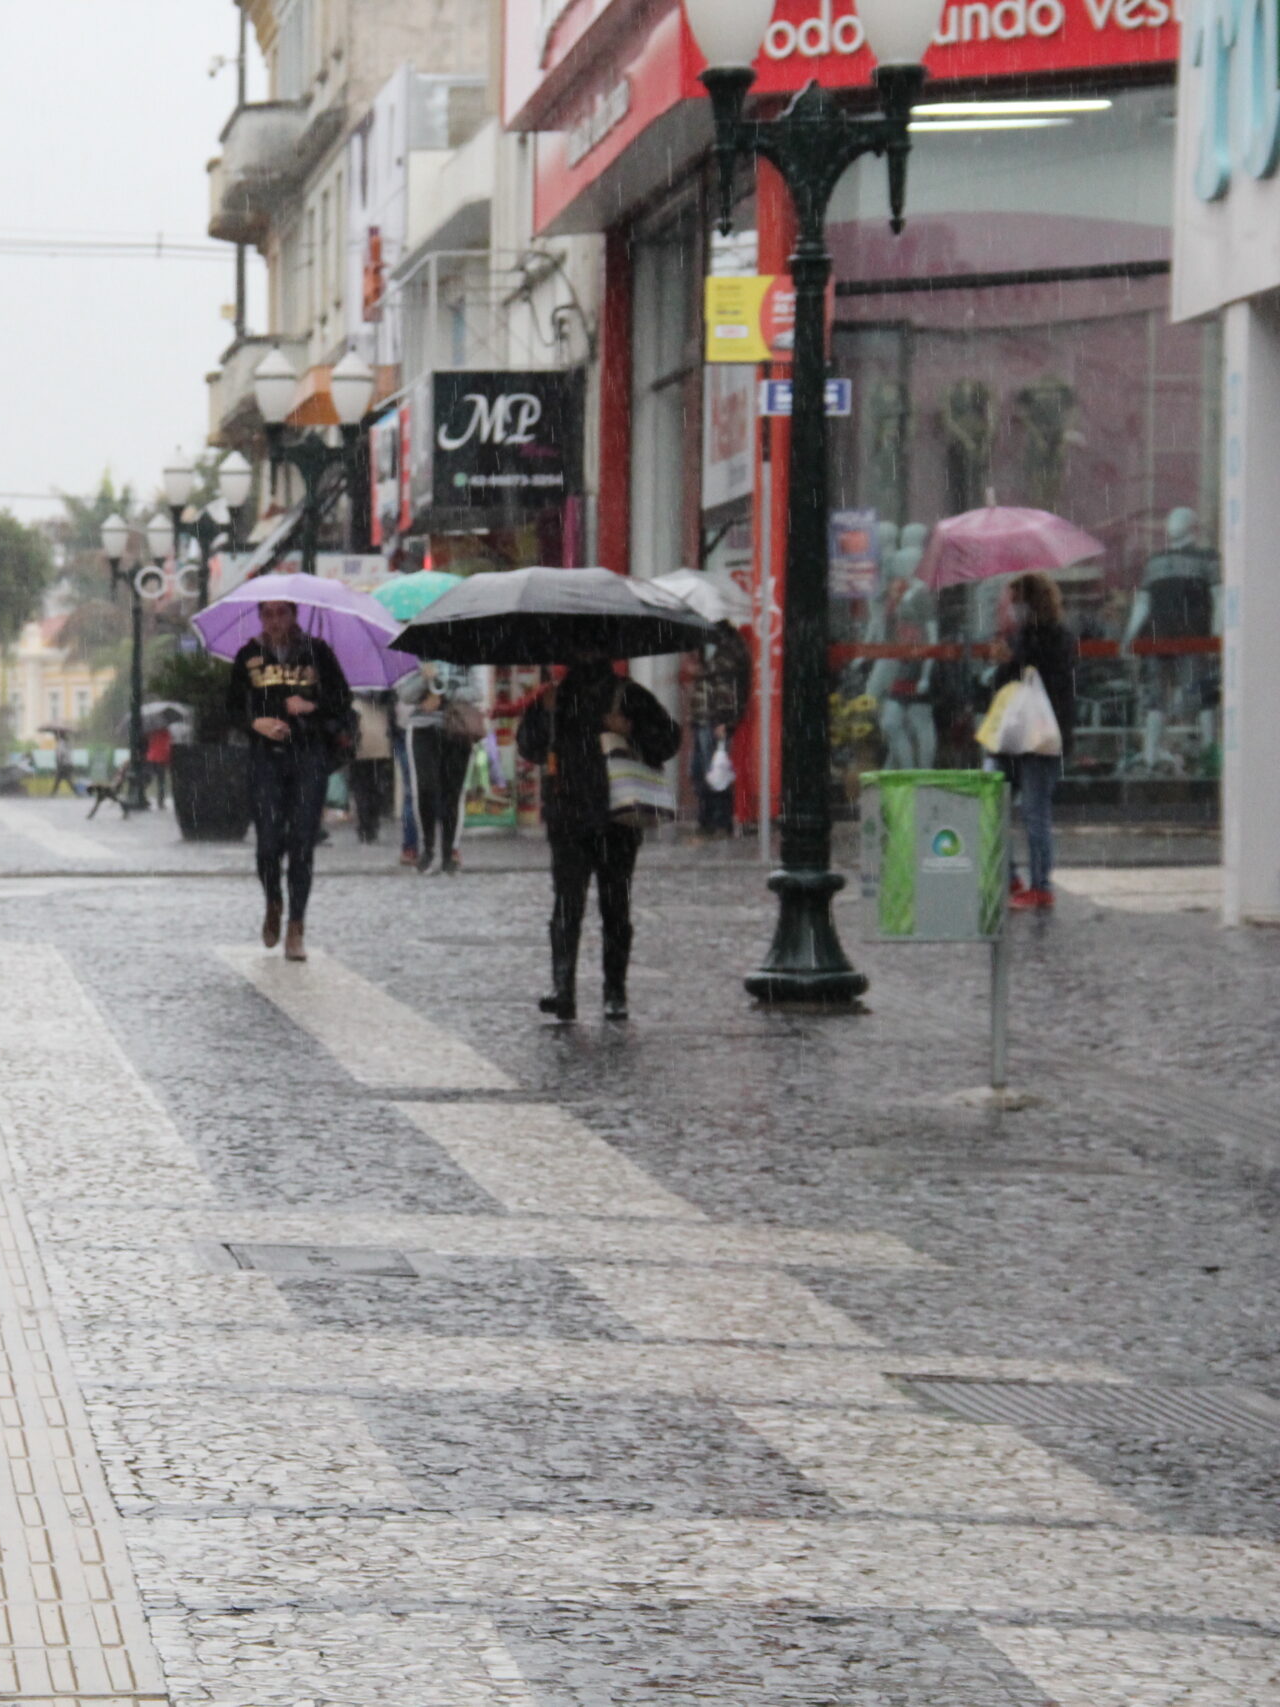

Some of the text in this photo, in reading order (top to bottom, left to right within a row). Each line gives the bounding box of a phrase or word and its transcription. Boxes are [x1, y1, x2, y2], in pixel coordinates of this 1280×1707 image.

[764, 0, 865, 58] odo
[932, 0, 1063, 45] undo
[438, 393, 542, 450] MP
